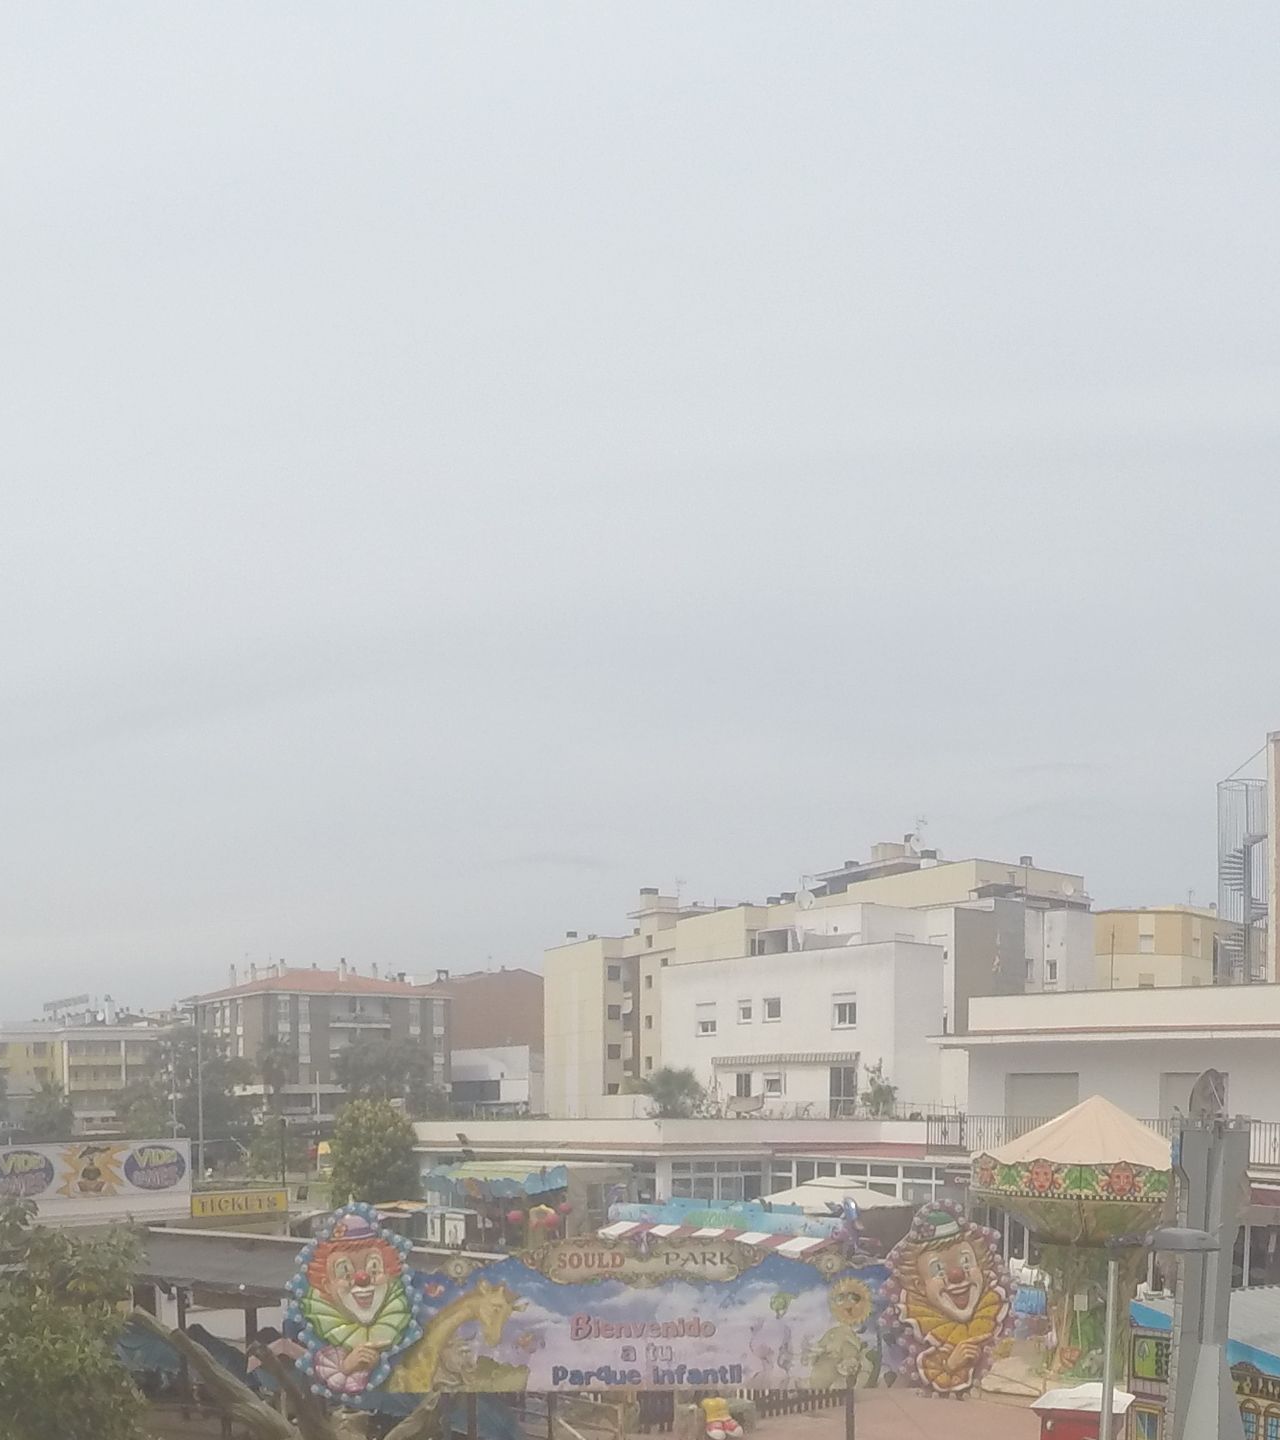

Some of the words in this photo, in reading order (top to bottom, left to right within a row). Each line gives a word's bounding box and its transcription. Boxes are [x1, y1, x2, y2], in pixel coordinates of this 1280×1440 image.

[200, 1195, 277, 1213] TICKETS
[557, 1252, 625, 1269] SOULD
[663, 1250, 734, 1266] PARK
[570, 1311, 716, 1340] Bienvenido
[621, 1345, 637, 1362] a
[645, 1342, 673, 1362] tu
[552, 1365, 642, 1385] Parque
